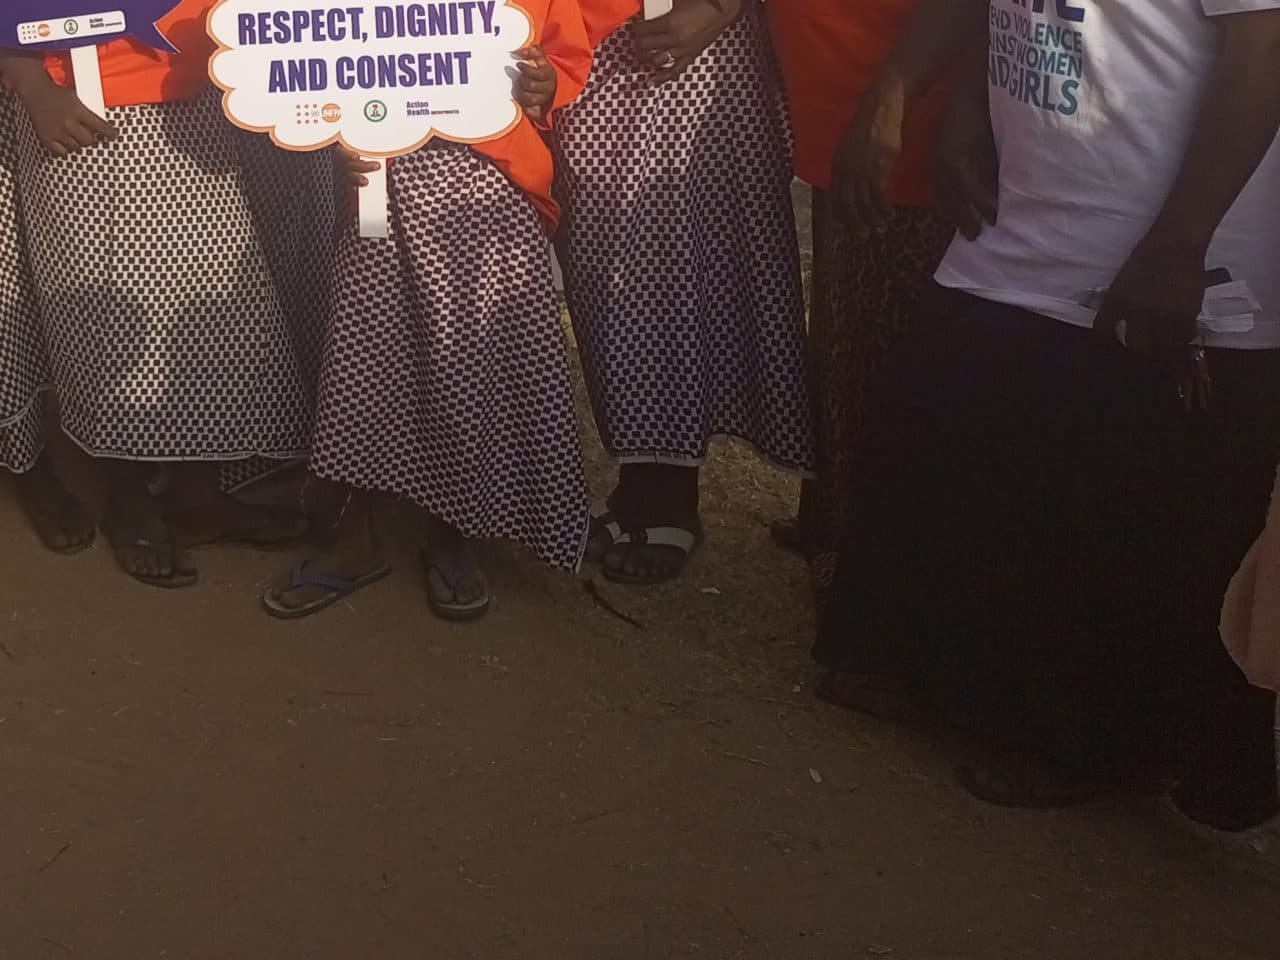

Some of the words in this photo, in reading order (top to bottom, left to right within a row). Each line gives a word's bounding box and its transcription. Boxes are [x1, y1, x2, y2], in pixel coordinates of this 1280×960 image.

[237, 7, 368, 45] RESPECT,
[374, 0, 500, 39] DIGNITY,
[1014, 12, 1082, 54] VIOLENCE
[268, 57, 328, 93] AND
[335, 51, 472, 90] CONSENT
[1016, 41, 1083, 79] WOMEN
[406, 101, 429, 109] Action
[988, 52, 1010, 88] ND
[1008, 62, 1080, 116] GIRLS
